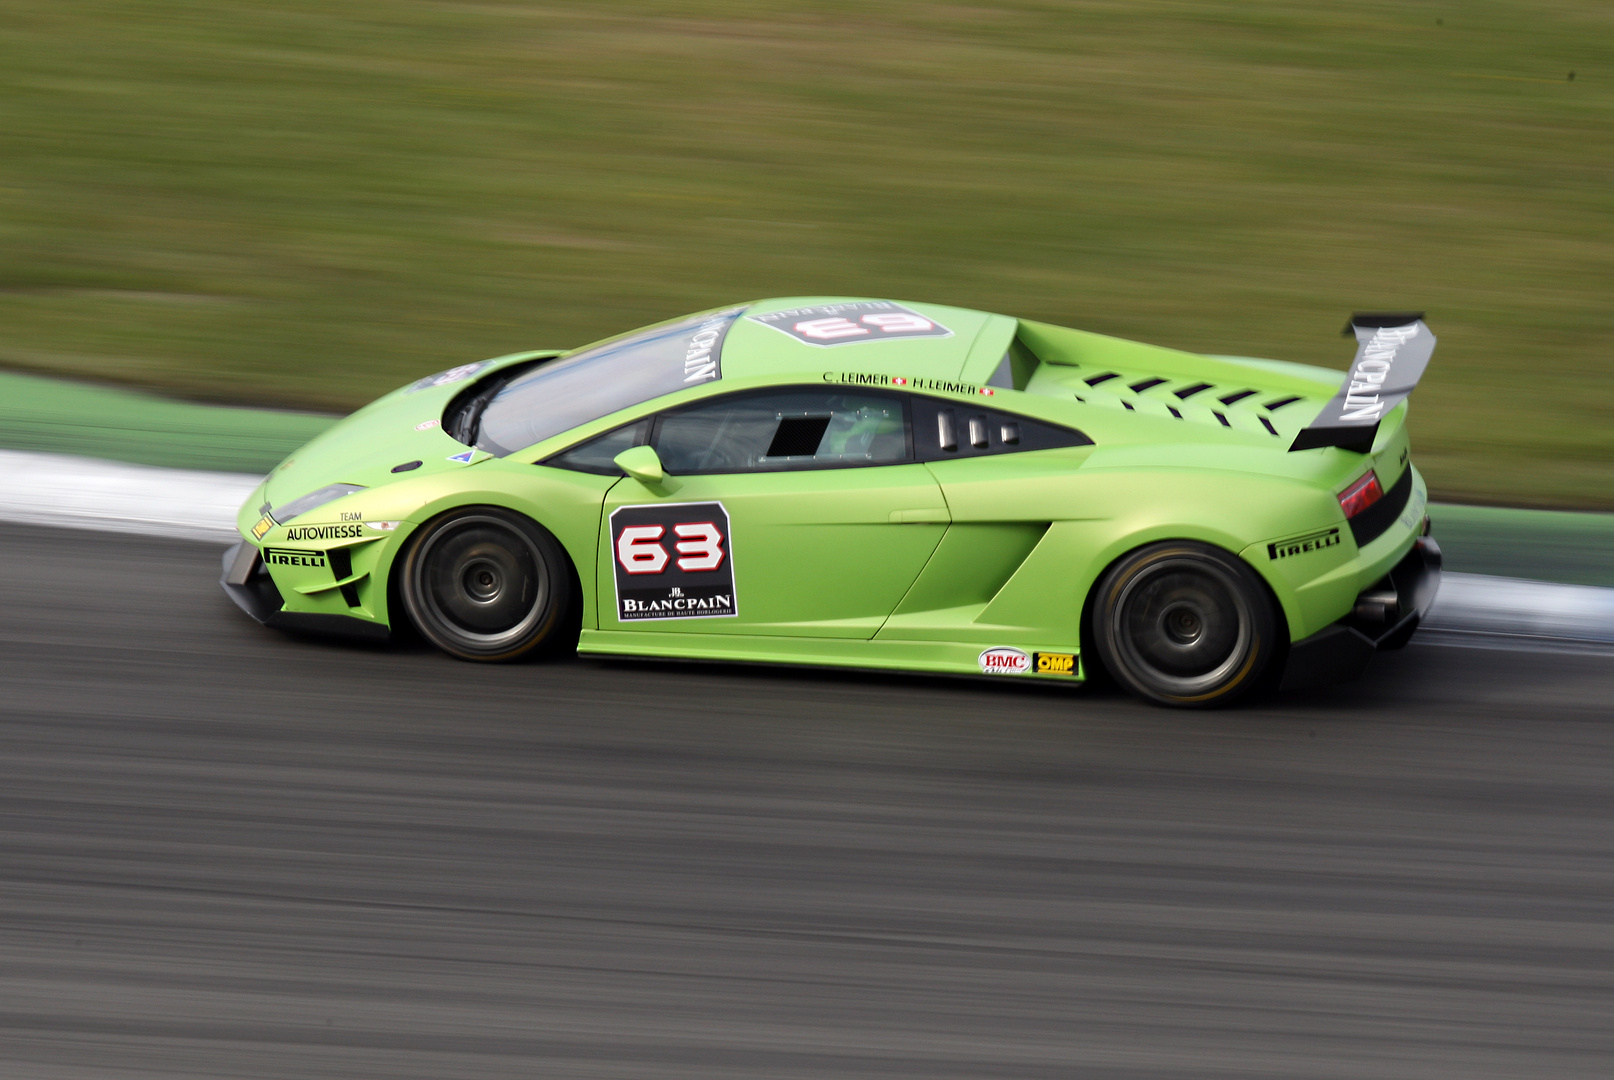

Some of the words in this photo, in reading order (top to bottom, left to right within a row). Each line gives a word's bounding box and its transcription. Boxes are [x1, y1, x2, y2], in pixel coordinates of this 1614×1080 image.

[794, 313, 934, 339] 63
[1338, 323, 1420, 421] BLANCPAIN
[340, 512, 362, 521] TEAM
[286, 525, 363, 541] AUTOVITESSE
[616, 521, 726, 575] 63
[1267, 527, 1340, 560] PIRELLI
[263, 547, 325, 567] PIRELLI
[623, 595, 731, 611] BLANCPAIN
[696, 608, 732, 616] HORLOGERIE
[985, 653, 1026, 668] BMC
[1037, 656, 1074, 670] OMP
